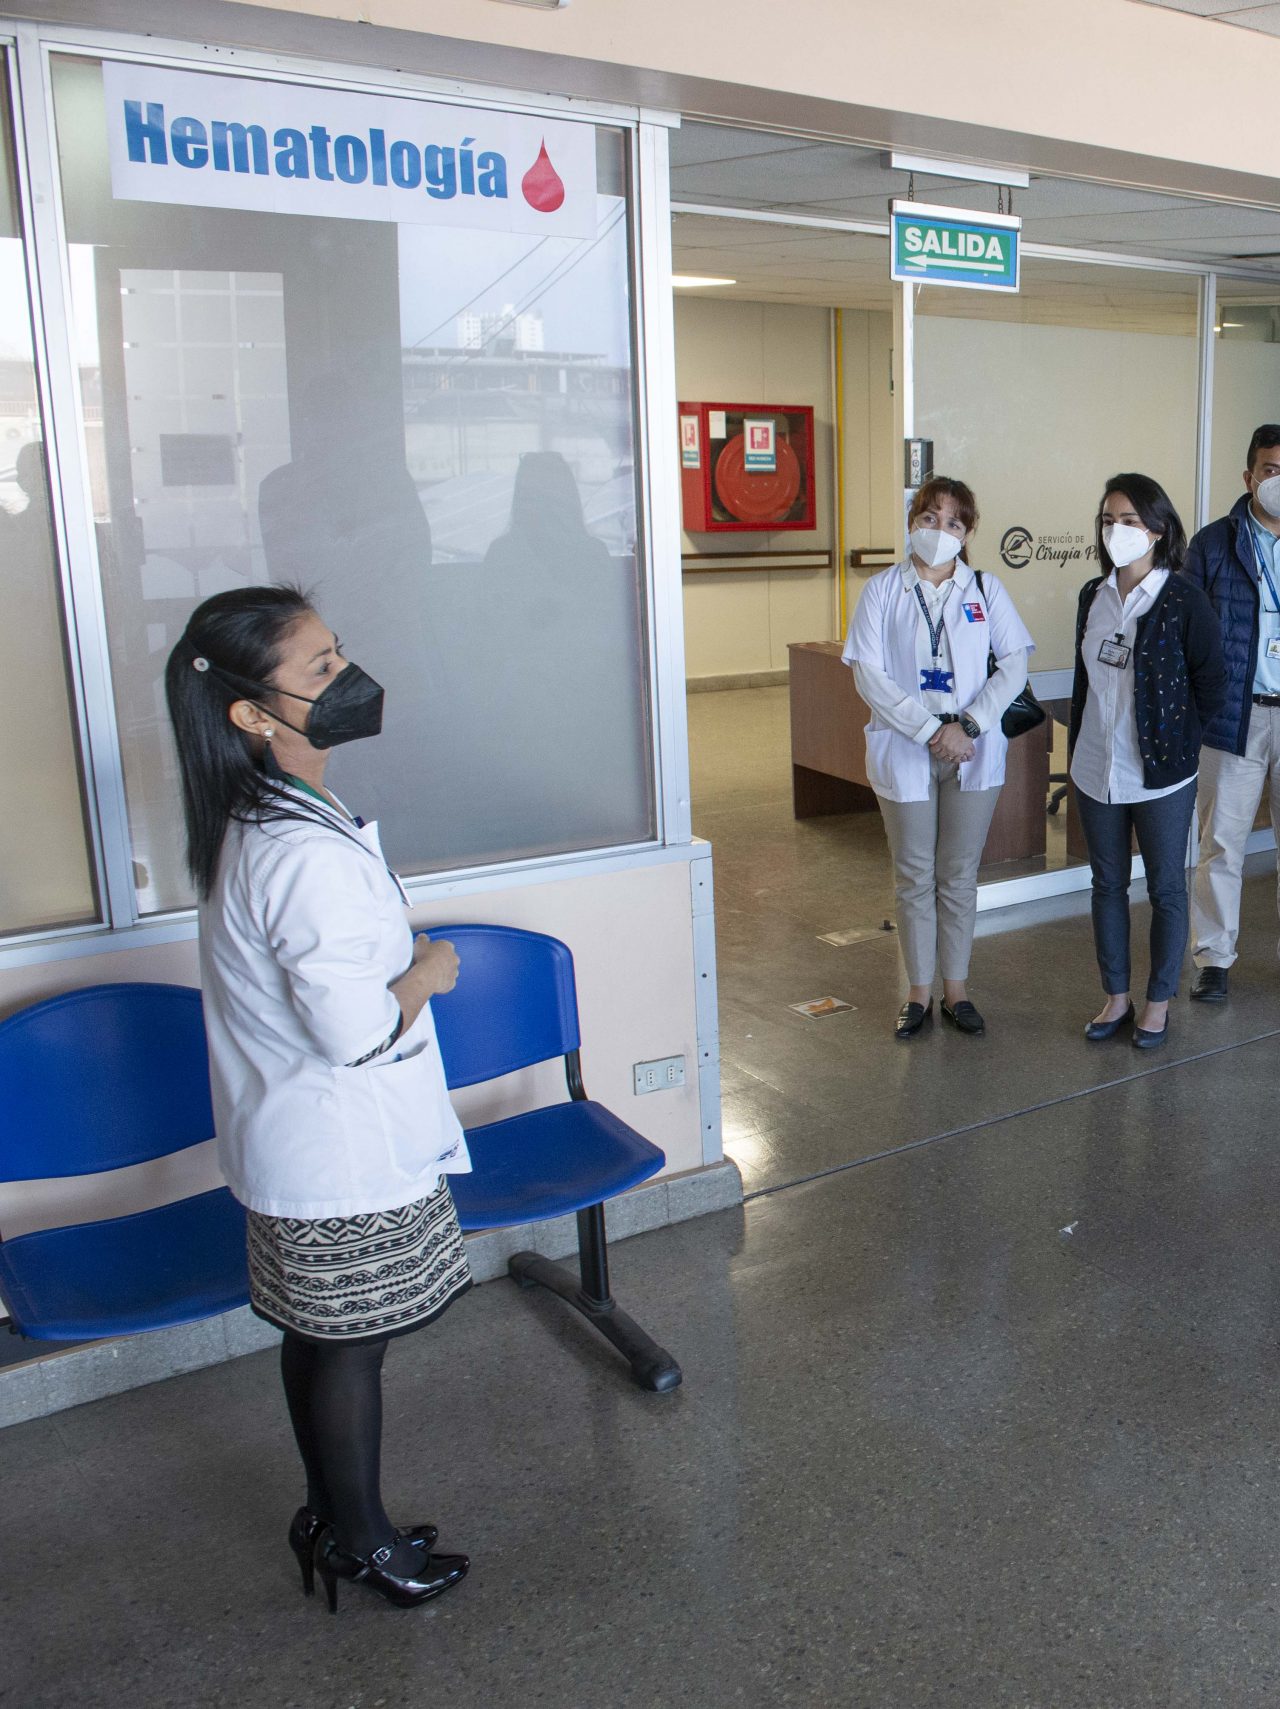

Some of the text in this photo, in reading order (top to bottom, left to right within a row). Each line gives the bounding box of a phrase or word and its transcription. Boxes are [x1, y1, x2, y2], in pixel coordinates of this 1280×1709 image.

[123, 100, 508, 199] Hematología
[904, 226, 1004, 260] SALIDA
[1075, 535, 1085, 543] DE
[1035, 544, 1083, 568] Cirugía
